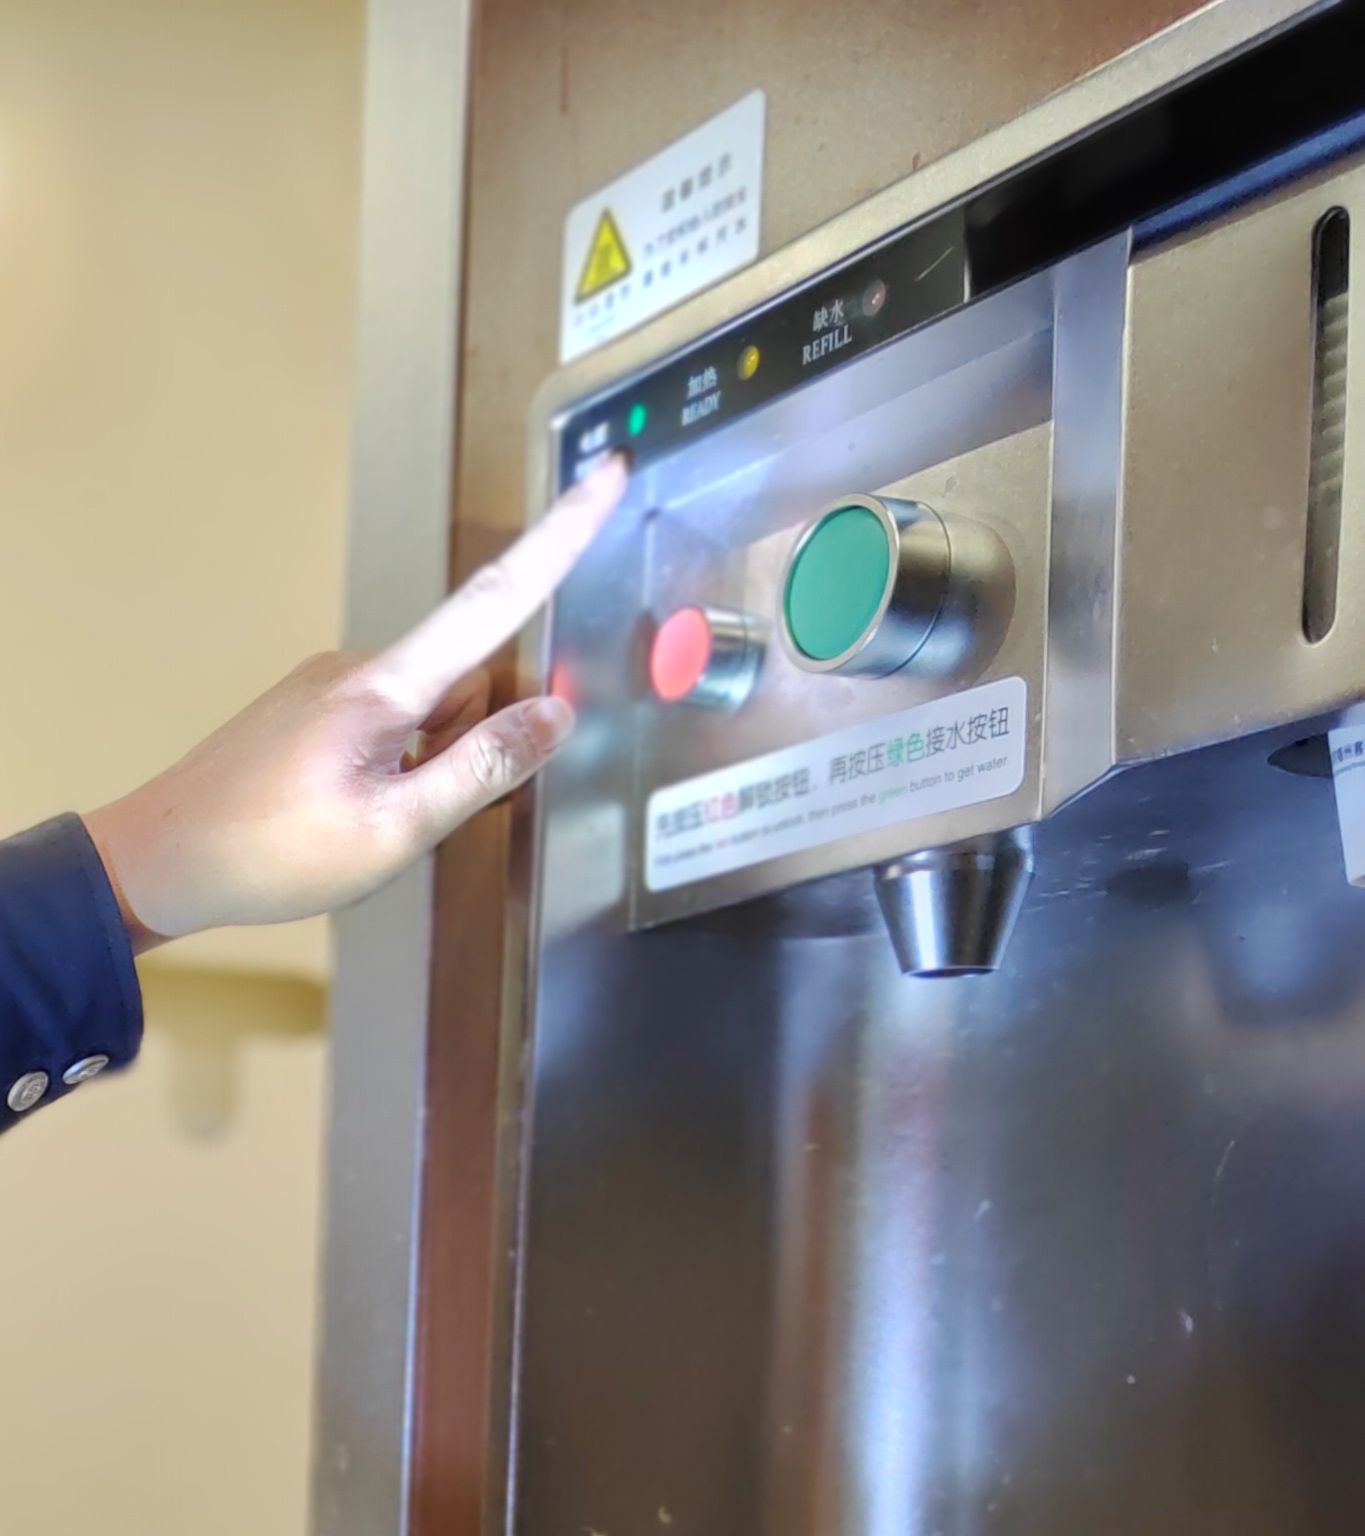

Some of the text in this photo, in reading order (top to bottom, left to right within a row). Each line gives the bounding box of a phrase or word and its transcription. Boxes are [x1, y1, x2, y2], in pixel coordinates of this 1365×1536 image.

[812, 298, 845, 332] 缺水
[802, 324, 853, 366] REFILL
[686, 365, 718, 400] 加热
[681, 390, 722, 427] READY
[831, 799, 858, 817] press
[860, 793, 876, 806] the
[878, 784, 907, 804] green
[909, 773, 942, 792] button
[944, 770, 955, 783] to
[957, 765, 974, 783] get
